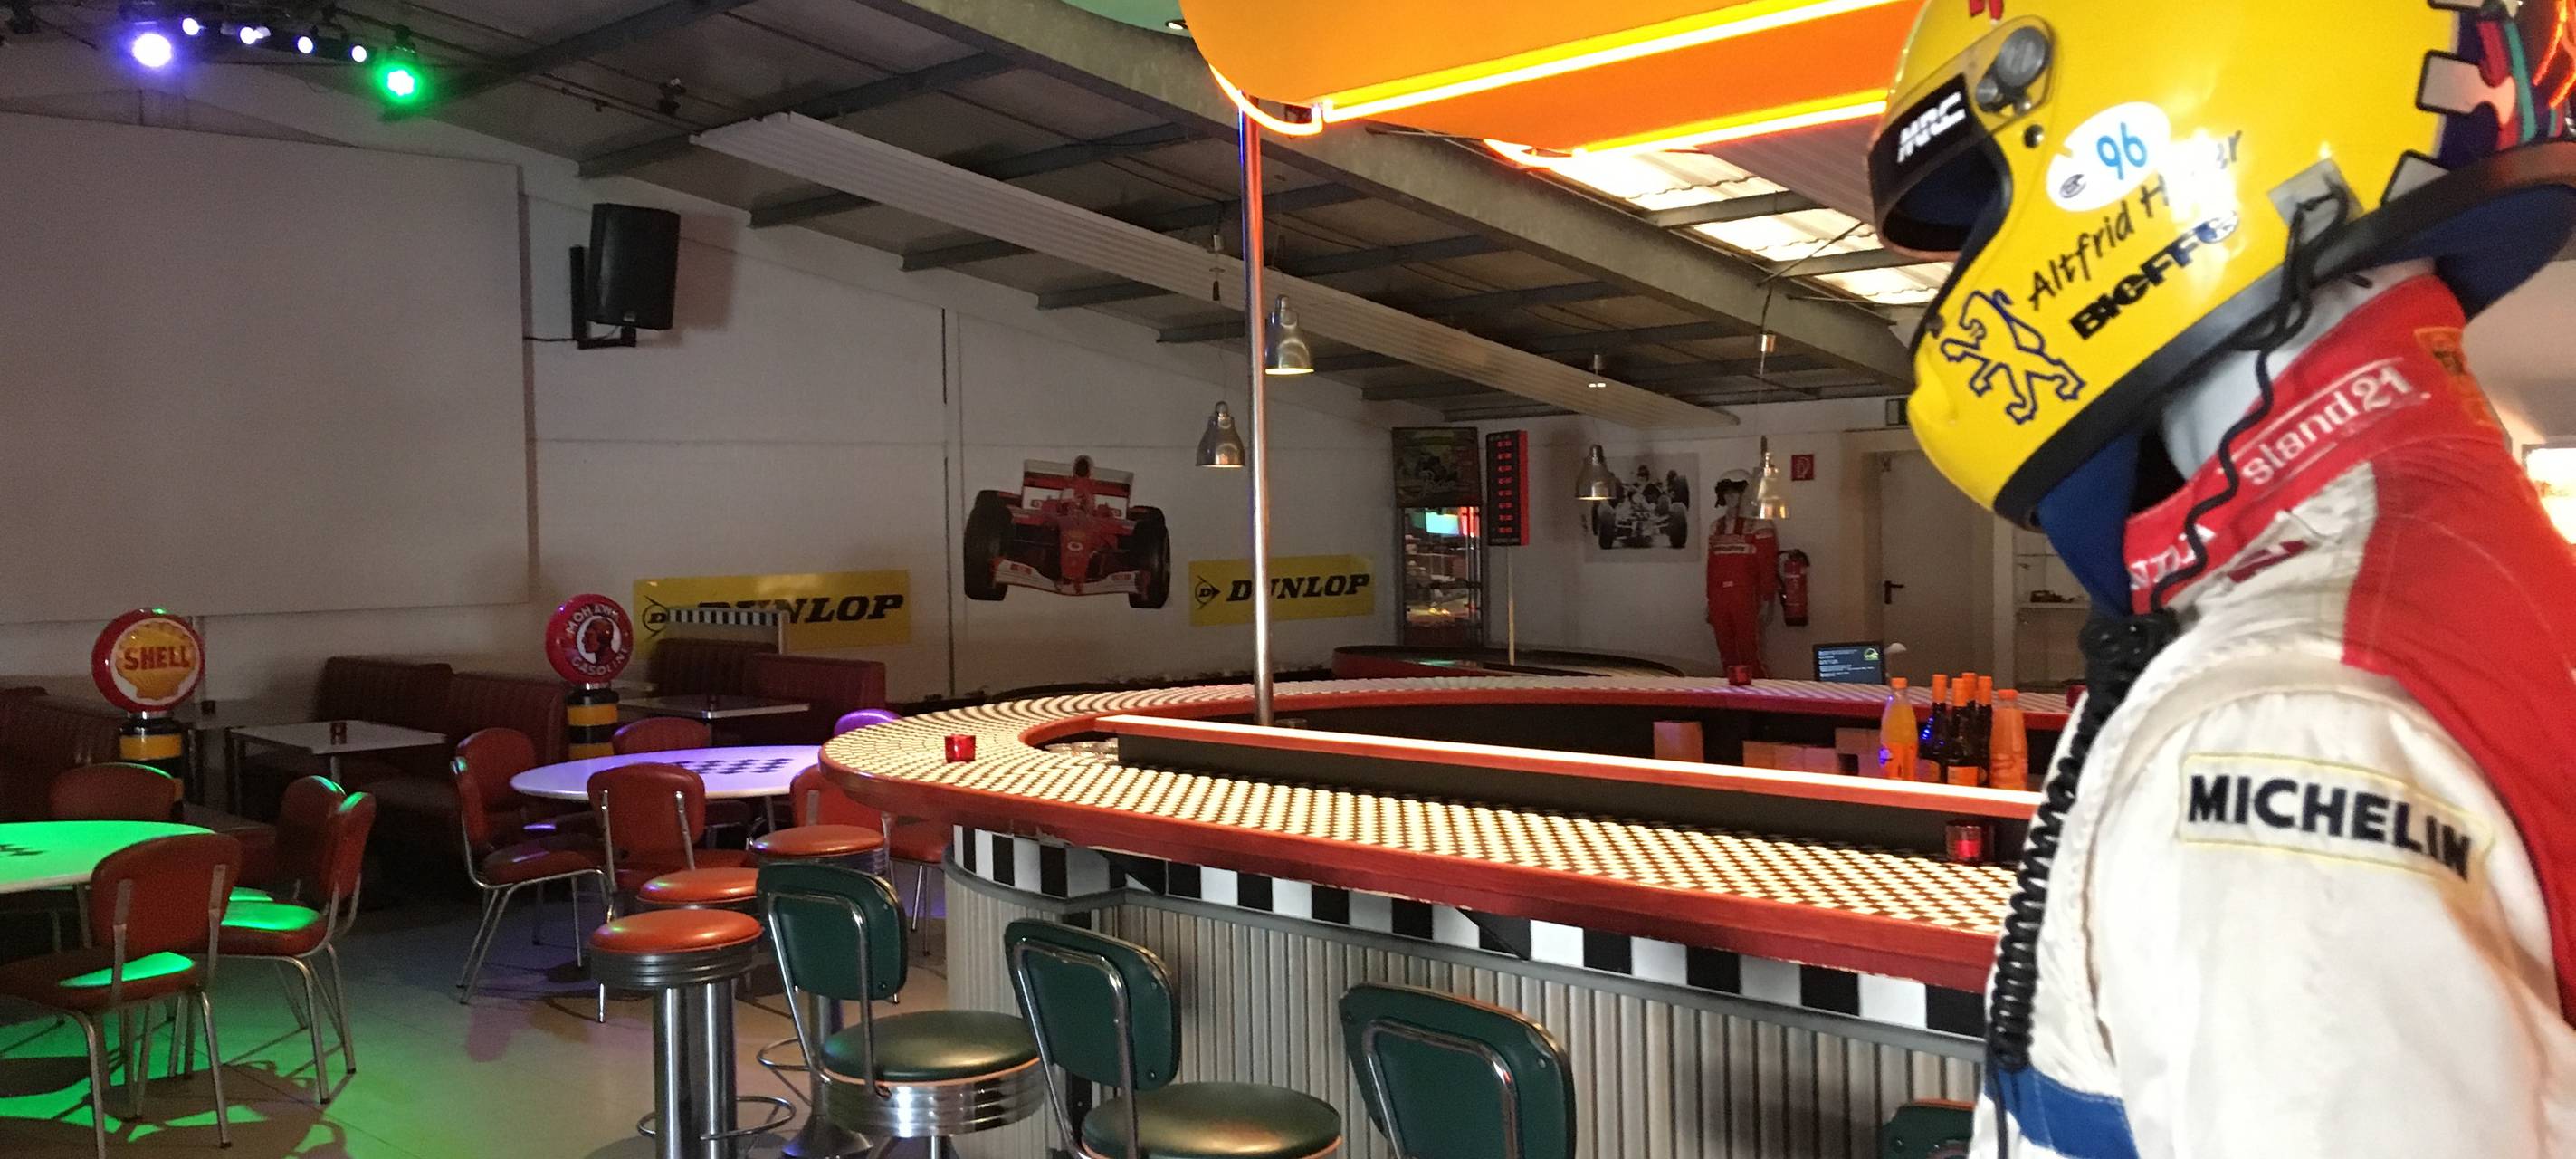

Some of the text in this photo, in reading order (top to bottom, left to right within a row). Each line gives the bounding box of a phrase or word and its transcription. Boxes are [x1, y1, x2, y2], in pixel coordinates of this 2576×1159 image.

[2096, 121, 2148, 180] 96
[2028, 198, 2135, 311] Altfrid
[1226, 573, 1370, 602] DNLOP
[566, 603, 619, 635] MOHAWK
[697, 594, 904, 625] NLOP
[123, 646, 191, 670] SHELL
[571, 647, 628, 676] GASOLINE
[2189, 774, 2472, 883] MICHELIN
